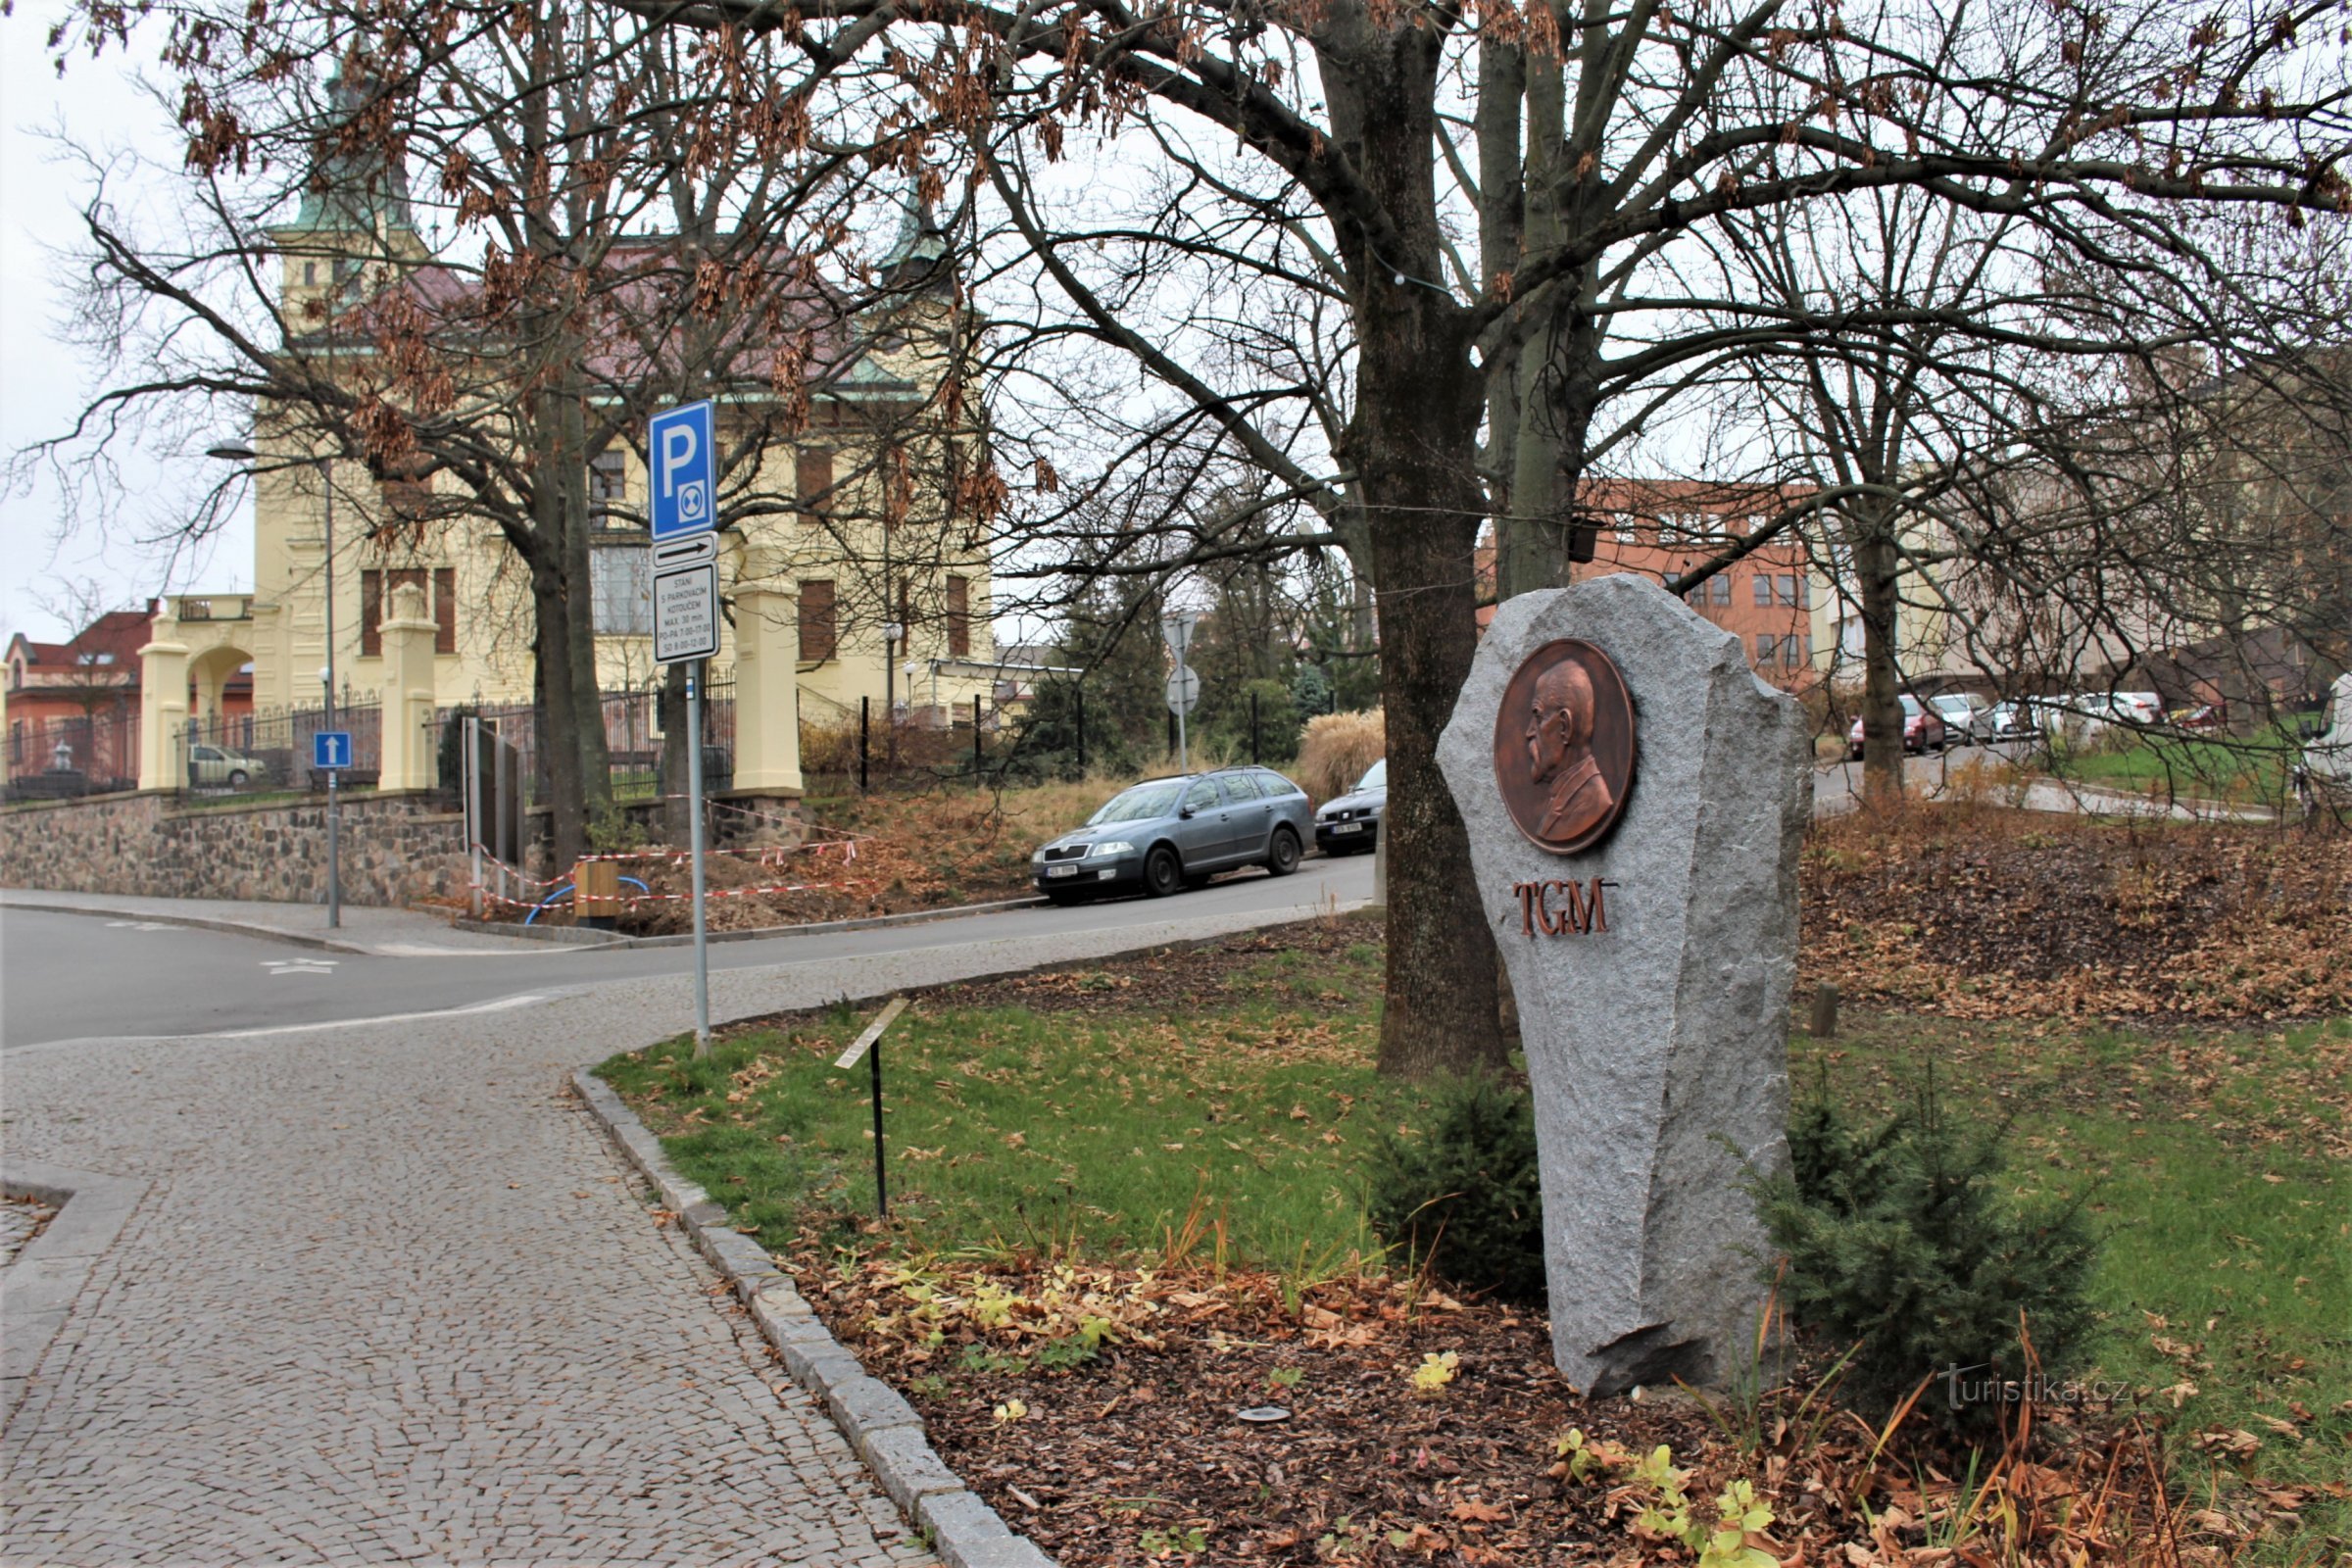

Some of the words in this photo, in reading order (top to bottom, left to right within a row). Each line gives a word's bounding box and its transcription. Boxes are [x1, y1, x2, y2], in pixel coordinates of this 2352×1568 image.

[662, 423, 697, 498] P
[673, 576, 692, 588] STÁNÍ
[661, 595, 666, 604] S
[667, 586, 707, 601] PARKOVACÍM
[667, 600, 701, 613] KOTOUČEM
[682, 615, 689, 624] 30
[1513, 877, 1611, 937] TGM
